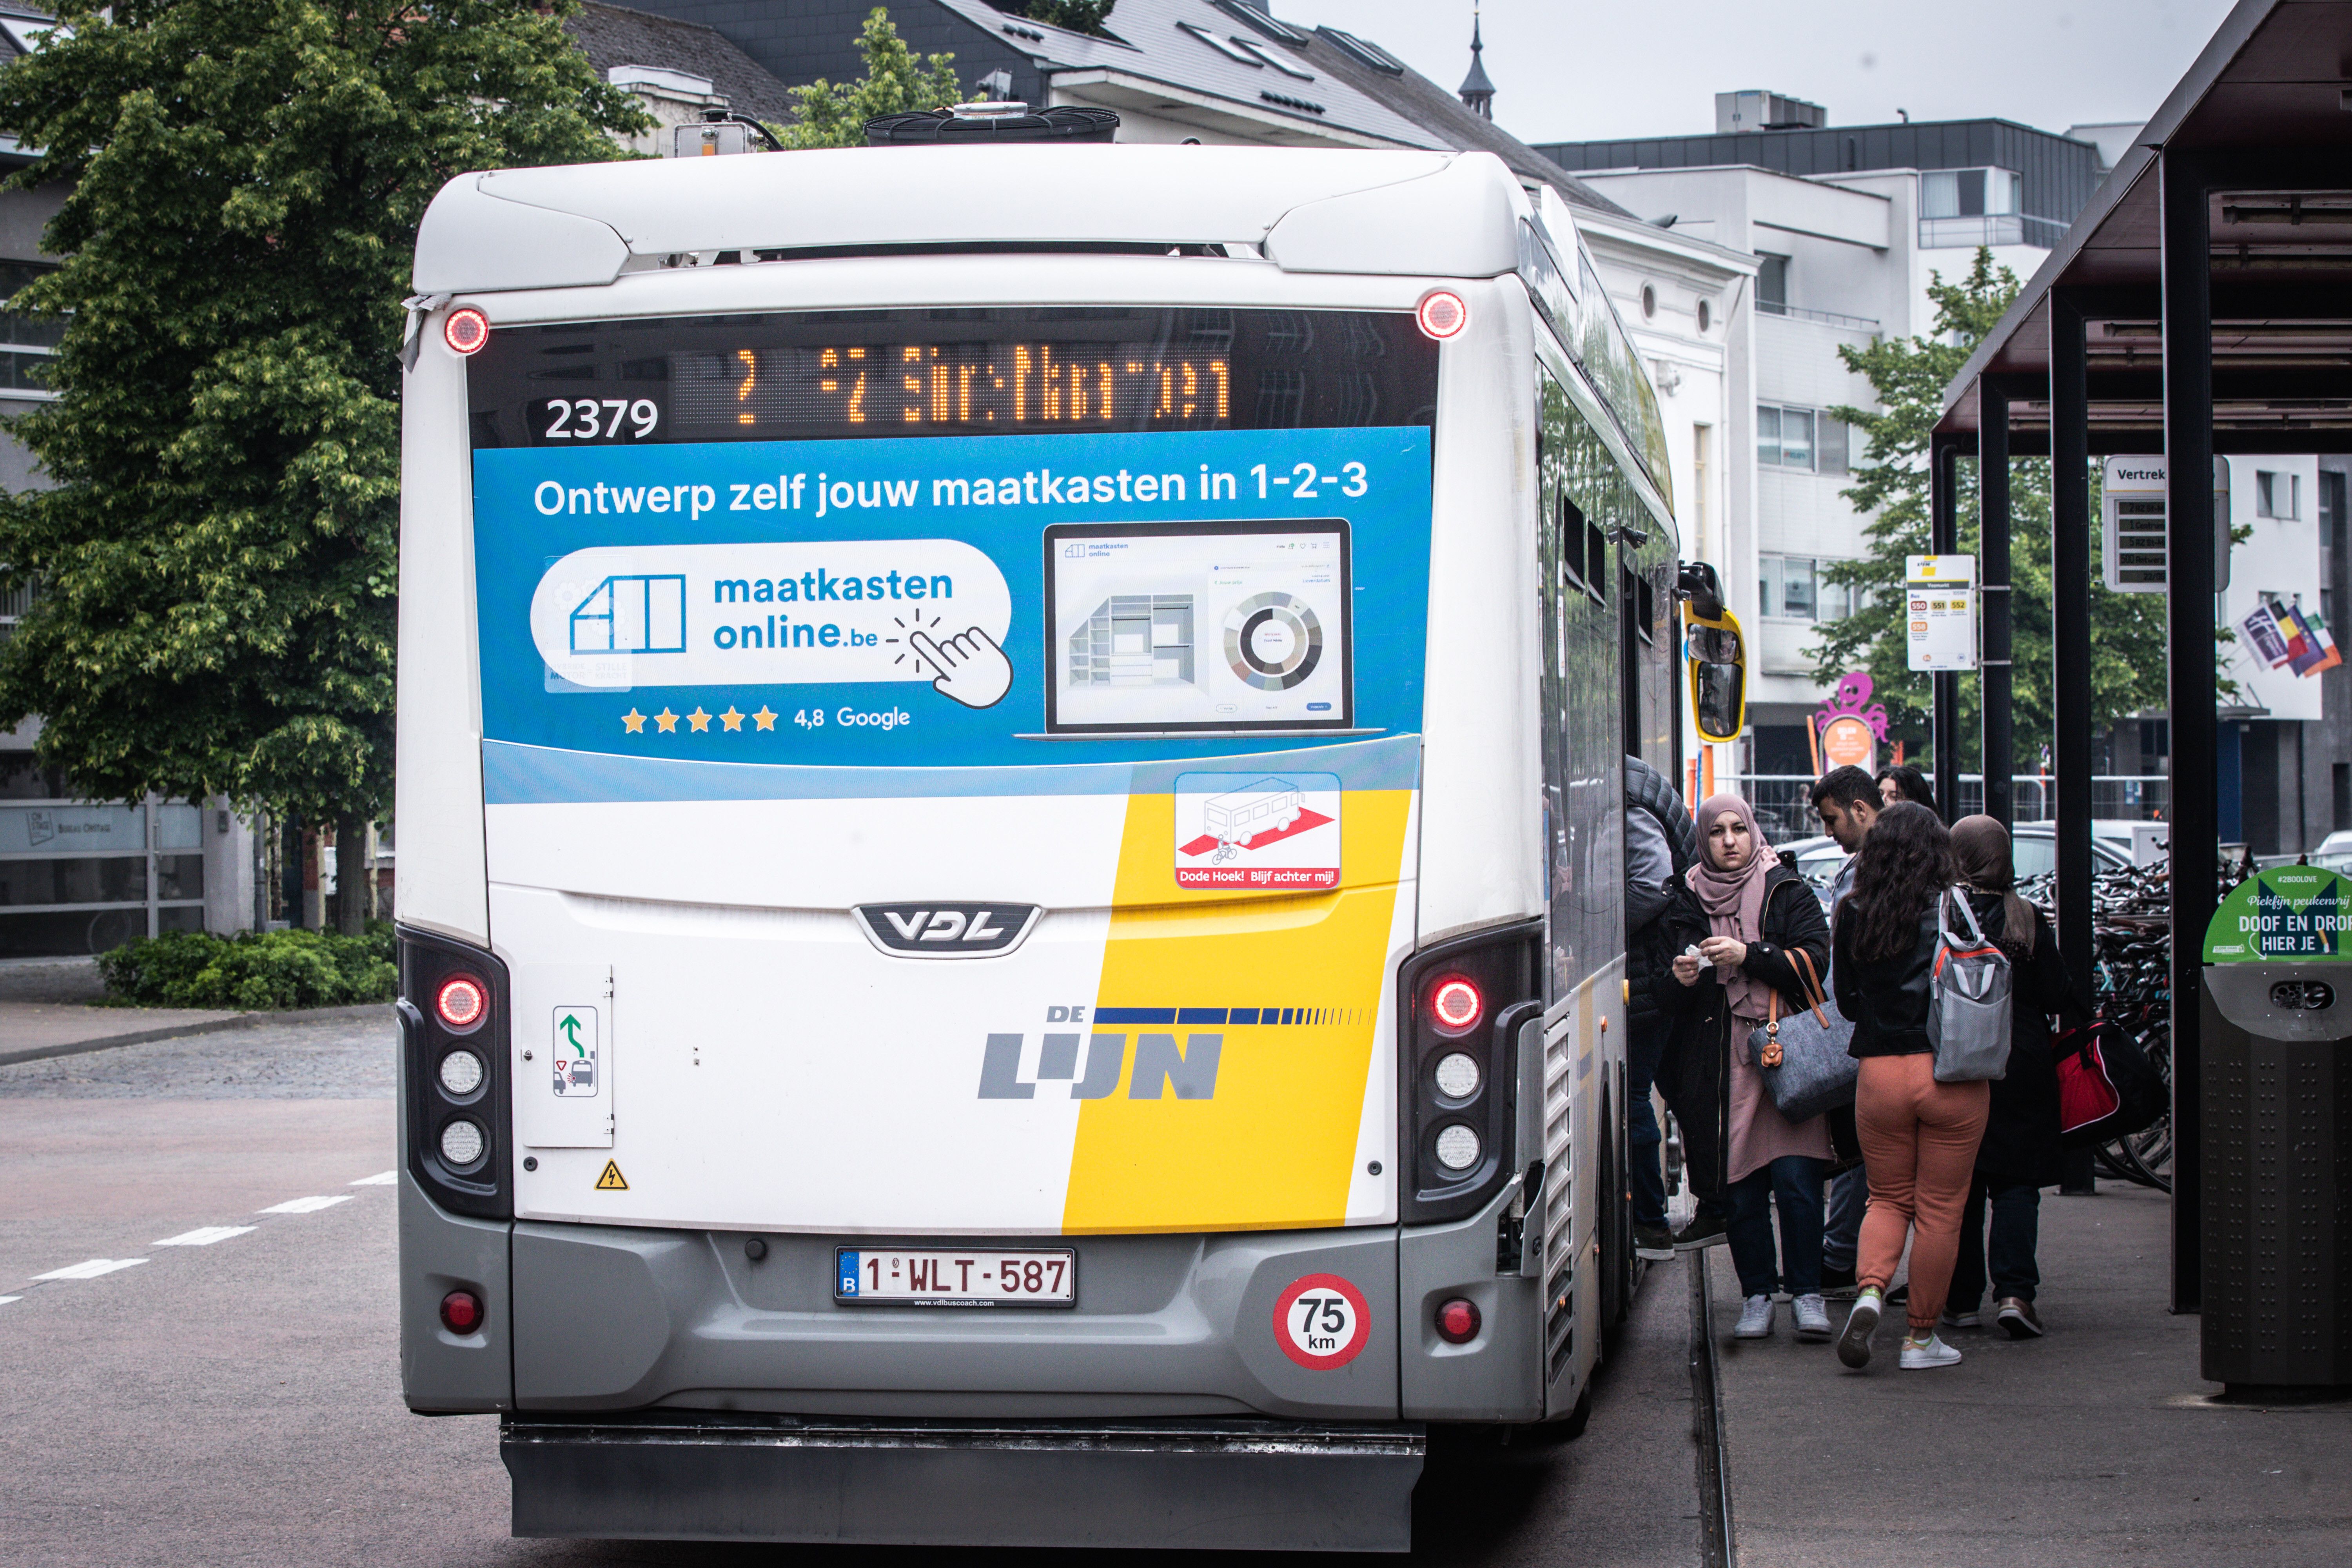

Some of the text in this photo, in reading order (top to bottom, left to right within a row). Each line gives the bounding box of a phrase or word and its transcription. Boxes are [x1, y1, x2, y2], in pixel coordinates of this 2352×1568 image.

[546, 399, 658, 439] 2379
[534, 461, 1368, 521] Ontwerp zelf jouw maatkasten in 1-2-3
[714, 568, 953, 603] maatkasten
[713, 614, 878, 650] online.be
[595, 662, 627, 671] STILLE
[794, 706, 910, 732] 4,8 Google
[1180, 871, 1334, 884] Dode Hoek! Blijf achter mij!
[2293, 895, 2350, 909] peukenvrij
[884, 911, 1005, 941] VDL
[2239, 915, 2281, 932] DOOF
[2287, 915, 2308, 931] EN
[2262, 936, 2315, 951] HIER JE
[1046, 1005, 1086, 1023] DE
[977, 1033, 1224, 1100] LIJN
[843, 1278, 856, 1293] B
[867, 1258, 1067, 1293] 1-WLT-587
[914, 1299, 995, 1307] www.vdlbuscoach.com
[1298, 1298, 1345, 1333] 75
[1308, 1334, 1335, 1348] km
